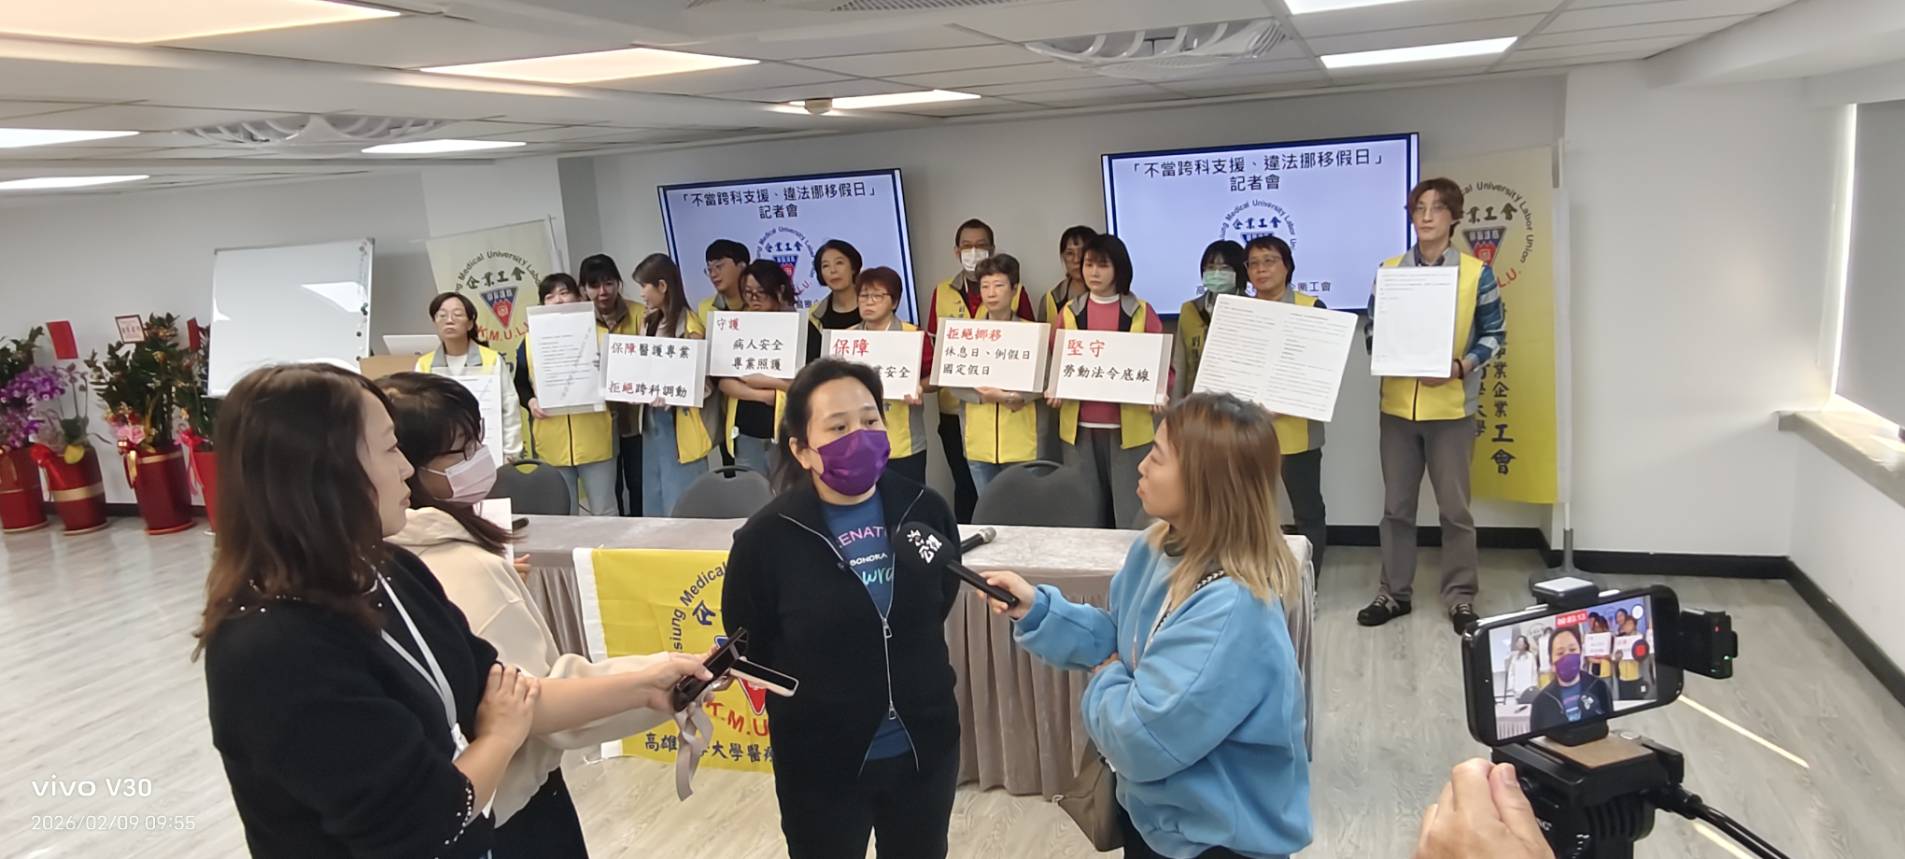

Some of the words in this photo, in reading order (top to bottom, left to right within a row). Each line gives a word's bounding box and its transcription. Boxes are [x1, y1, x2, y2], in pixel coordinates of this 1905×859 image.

[1134, 149, 1384, 178] 「不當跨科支援、違法挪移假日」
[1229, 174, 1281, 192] 記者會
[1476, 181, 1522, 202] University
[681, 182, 877, 207] 「不當跨科支援、違法挪移假日」
[759, 203, 800, 219] 記者會
[1465, 203, 1518, 224] 業工會
[1520, 200, 1534, 231] Labor
[1520, 234, 1535, 263] Union
[717, 318, 739, 330] 守護
[947, 327, 1002, 341] 拒絕挪移
[611, 342, 690, 358] 保障醫護專業
[733, 338, 783, 351] 病人安全
[833, 338, 869, 357] 保障
[945, 345, 1030, 360] 休息日、例假日
[1067, 339, 1105, 358] 堅守
[732, 357, 781, 371] 專業照護
[943, 363, 990, 375] 國定假日
[1063, 364, 1150, 382] 勞動法令底線
[608, 381, 687, 398] 拒絕跨科調動
[669, 608, 687, 651] siung
